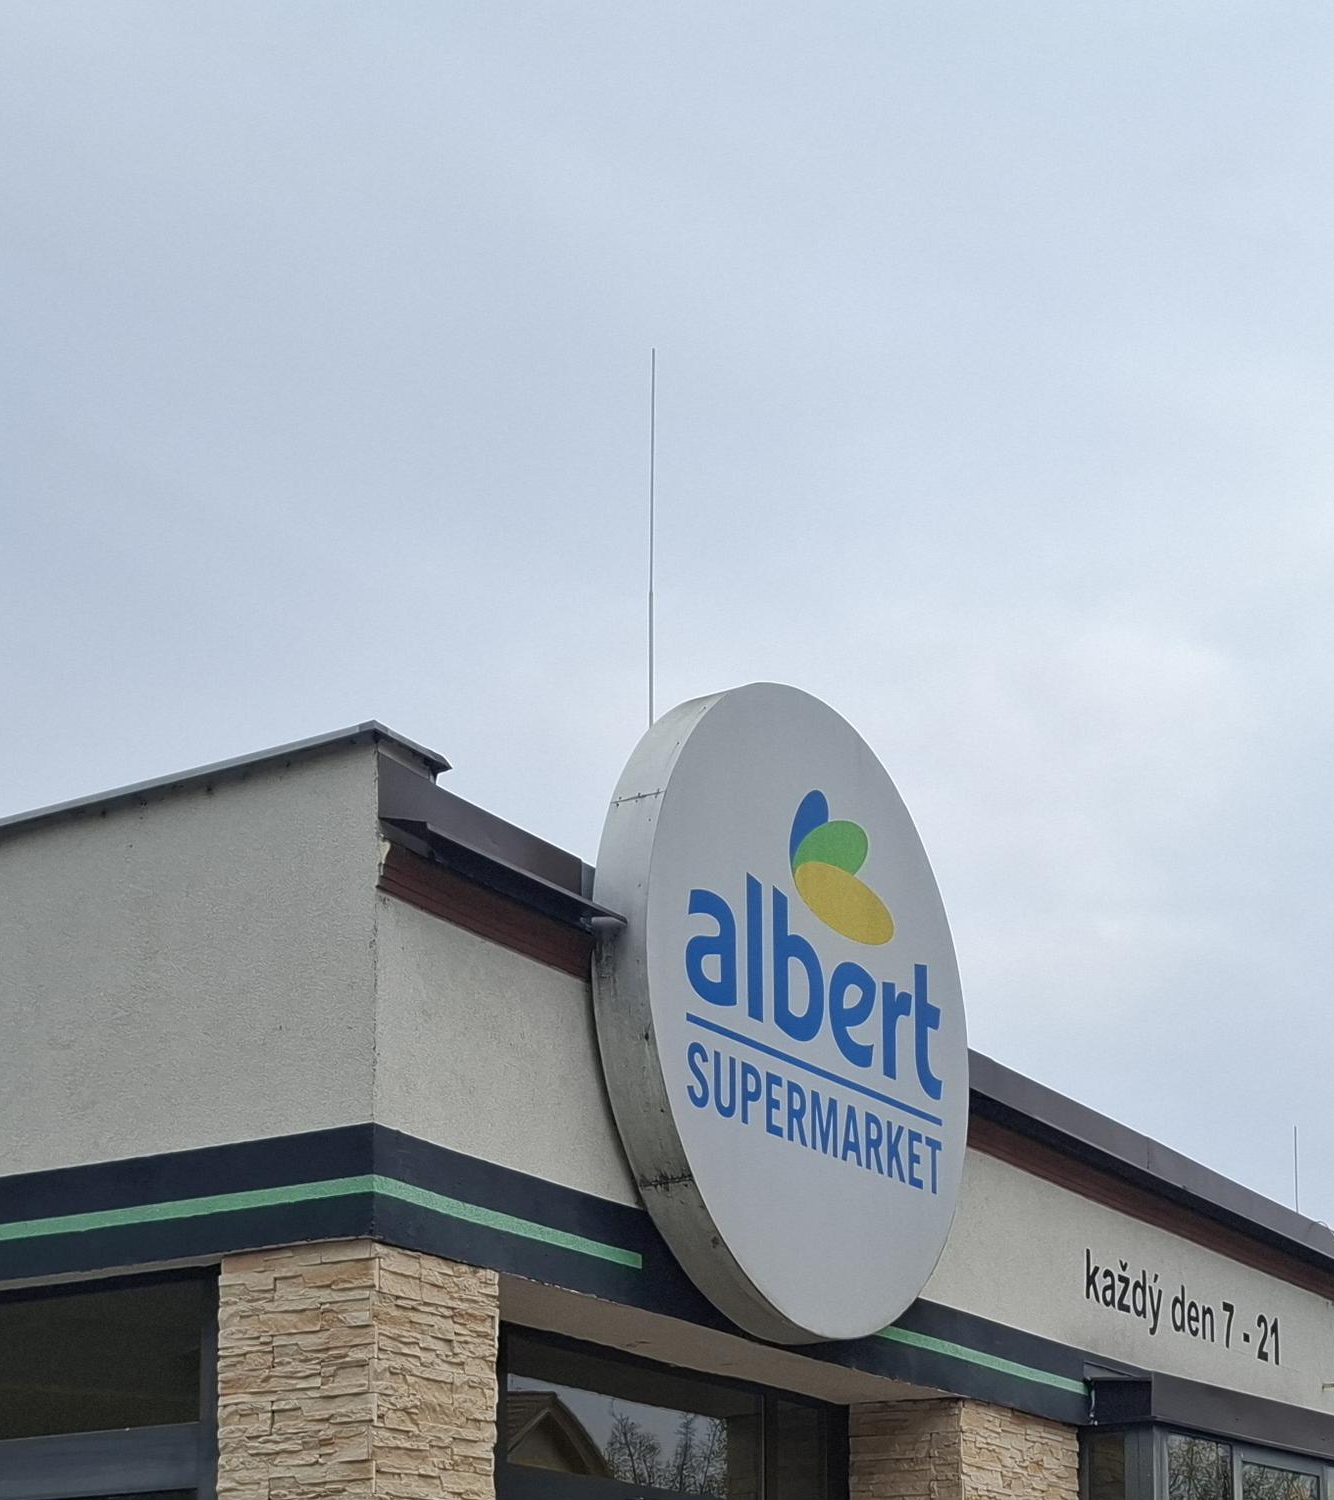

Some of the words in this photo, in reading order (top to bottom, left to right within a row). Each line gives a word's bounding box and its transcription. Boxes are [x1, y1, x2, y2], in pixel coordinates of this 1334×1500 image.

[685, 871, 942, 1100] albert
[686, 1041, 942, 1196] SUPERMARKET
[1085, 1248, 1162, 1335] každý
[1172, 1285, 1215, 1342] den
[1222, 1302, 1235, 1348] 7
[1257, 1315, 1280, 1365] 21
